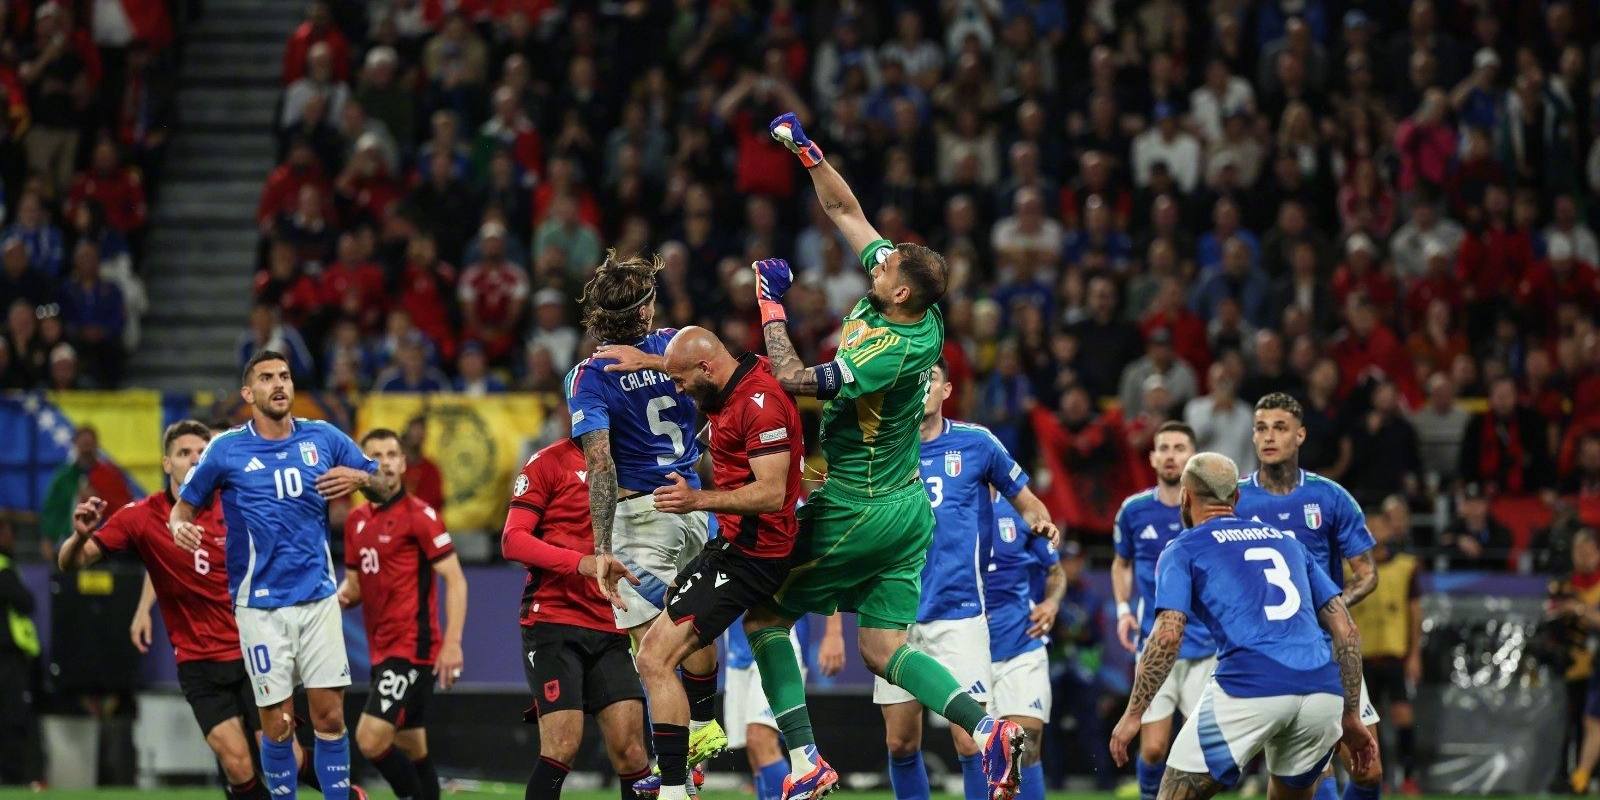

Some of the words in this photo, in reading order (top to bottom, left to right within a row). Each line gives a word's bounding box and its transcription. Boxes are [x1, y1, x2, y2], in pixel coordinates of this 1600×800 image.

[646, 395, 686, 467] 5
[273, 467, 303, 500] 10
[920, 476, 944, 508] 3
[1211, 527, 1284, 544] DIMARCO
[194, 548, 211, 576] 6
[359, 547, 380, 575] 20
[1243, 546, 1301, 621] 3
[247, 644, 271, 676] 10
[377, 668, 409, 701] 20
